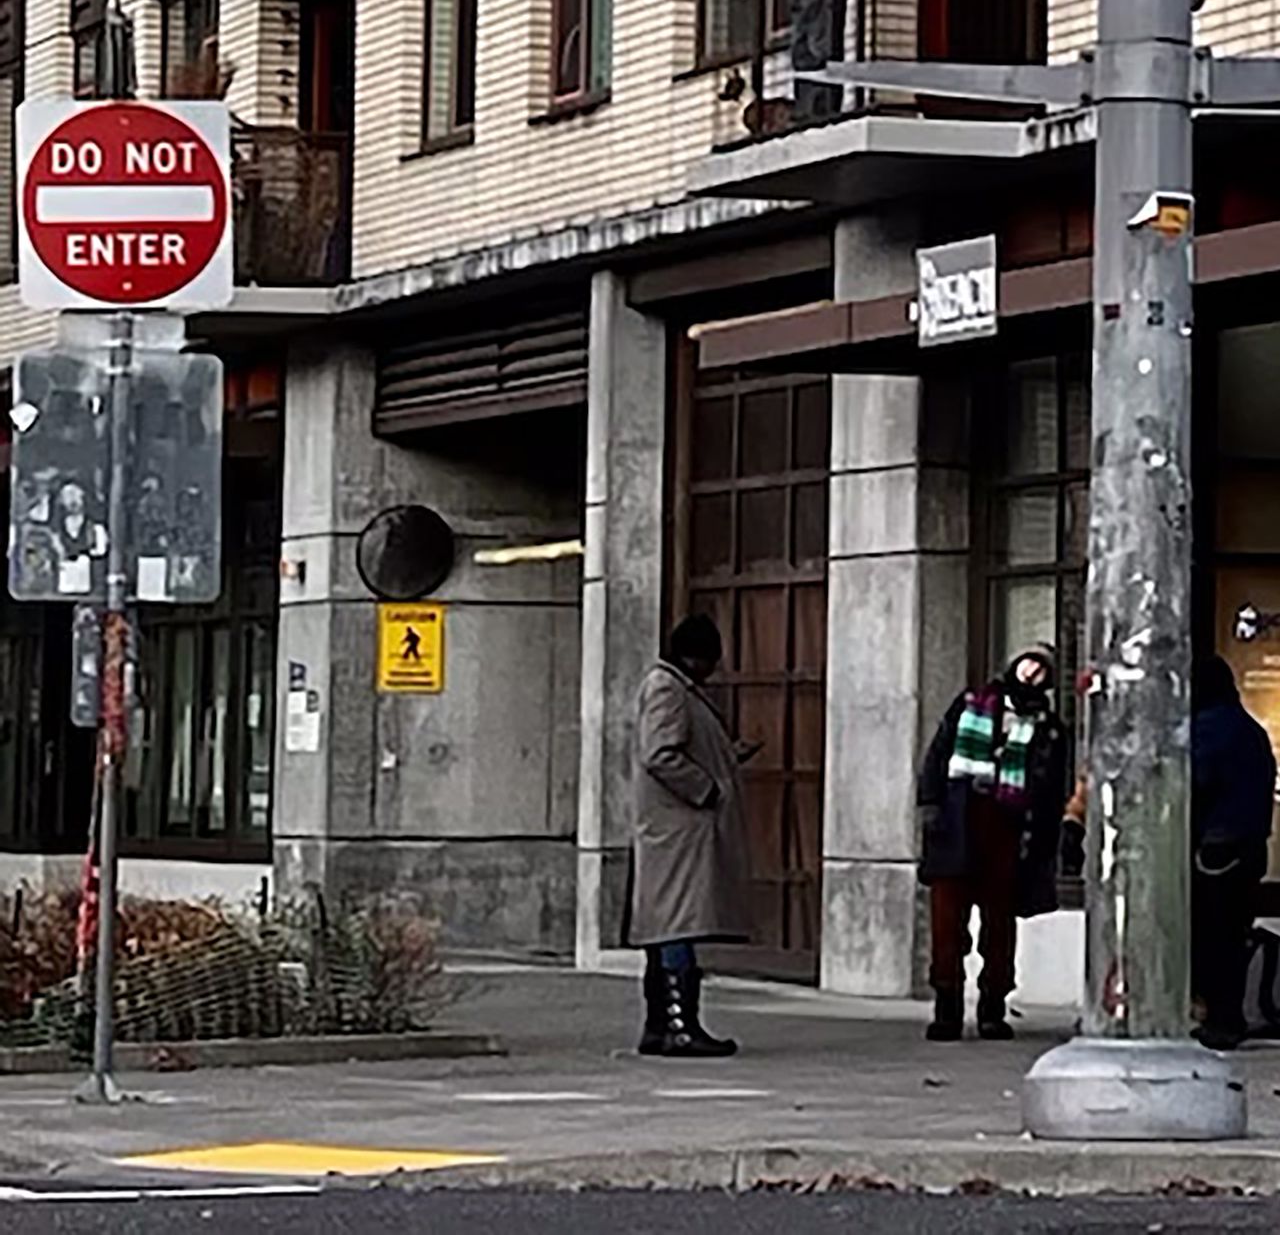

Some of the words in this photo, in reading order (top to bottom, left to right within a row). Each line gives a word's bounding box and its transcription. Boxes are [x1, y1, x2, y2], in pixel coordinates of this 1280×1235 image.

[52, 141, 103, 175] DO
[125, 141, 198, 174] NOT
[66, 233, 187, 266] ENTER
